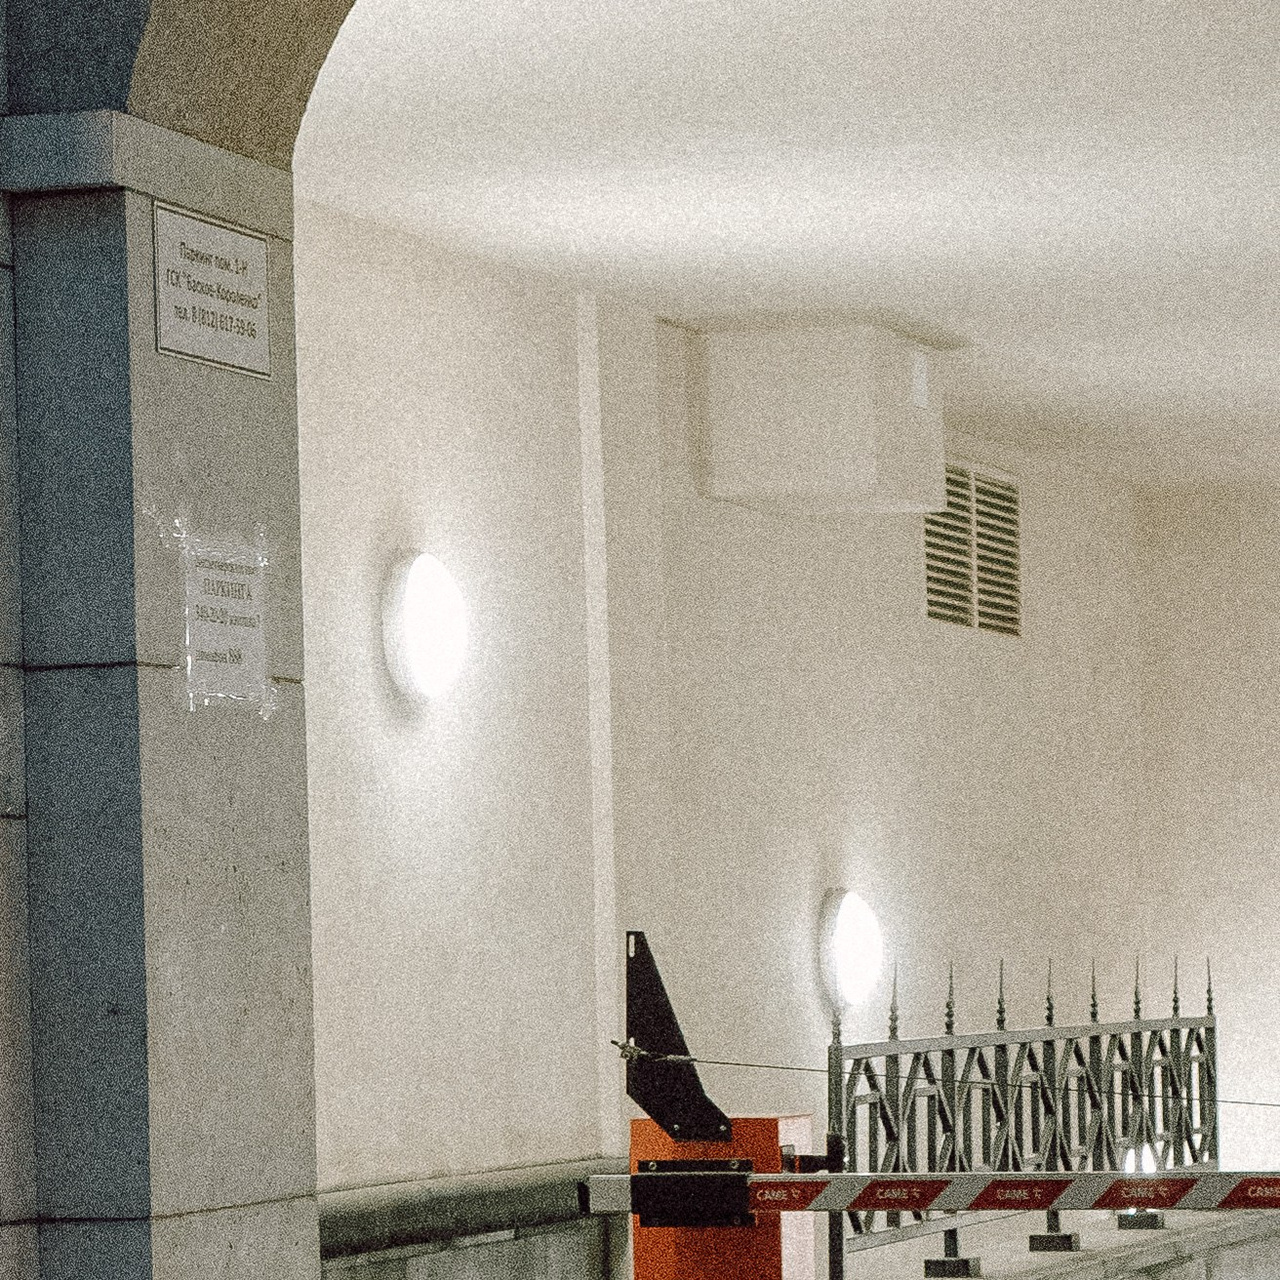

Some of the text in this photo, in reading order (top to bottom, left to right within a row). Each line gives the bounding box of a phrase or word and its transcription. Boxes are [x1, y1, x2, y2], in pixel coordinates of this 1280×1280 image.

[756, 1189, 789, 1201] CAME
[876, 1188, 910, 1200] CAME
[996, 1189, 1029, 1200] CAME
